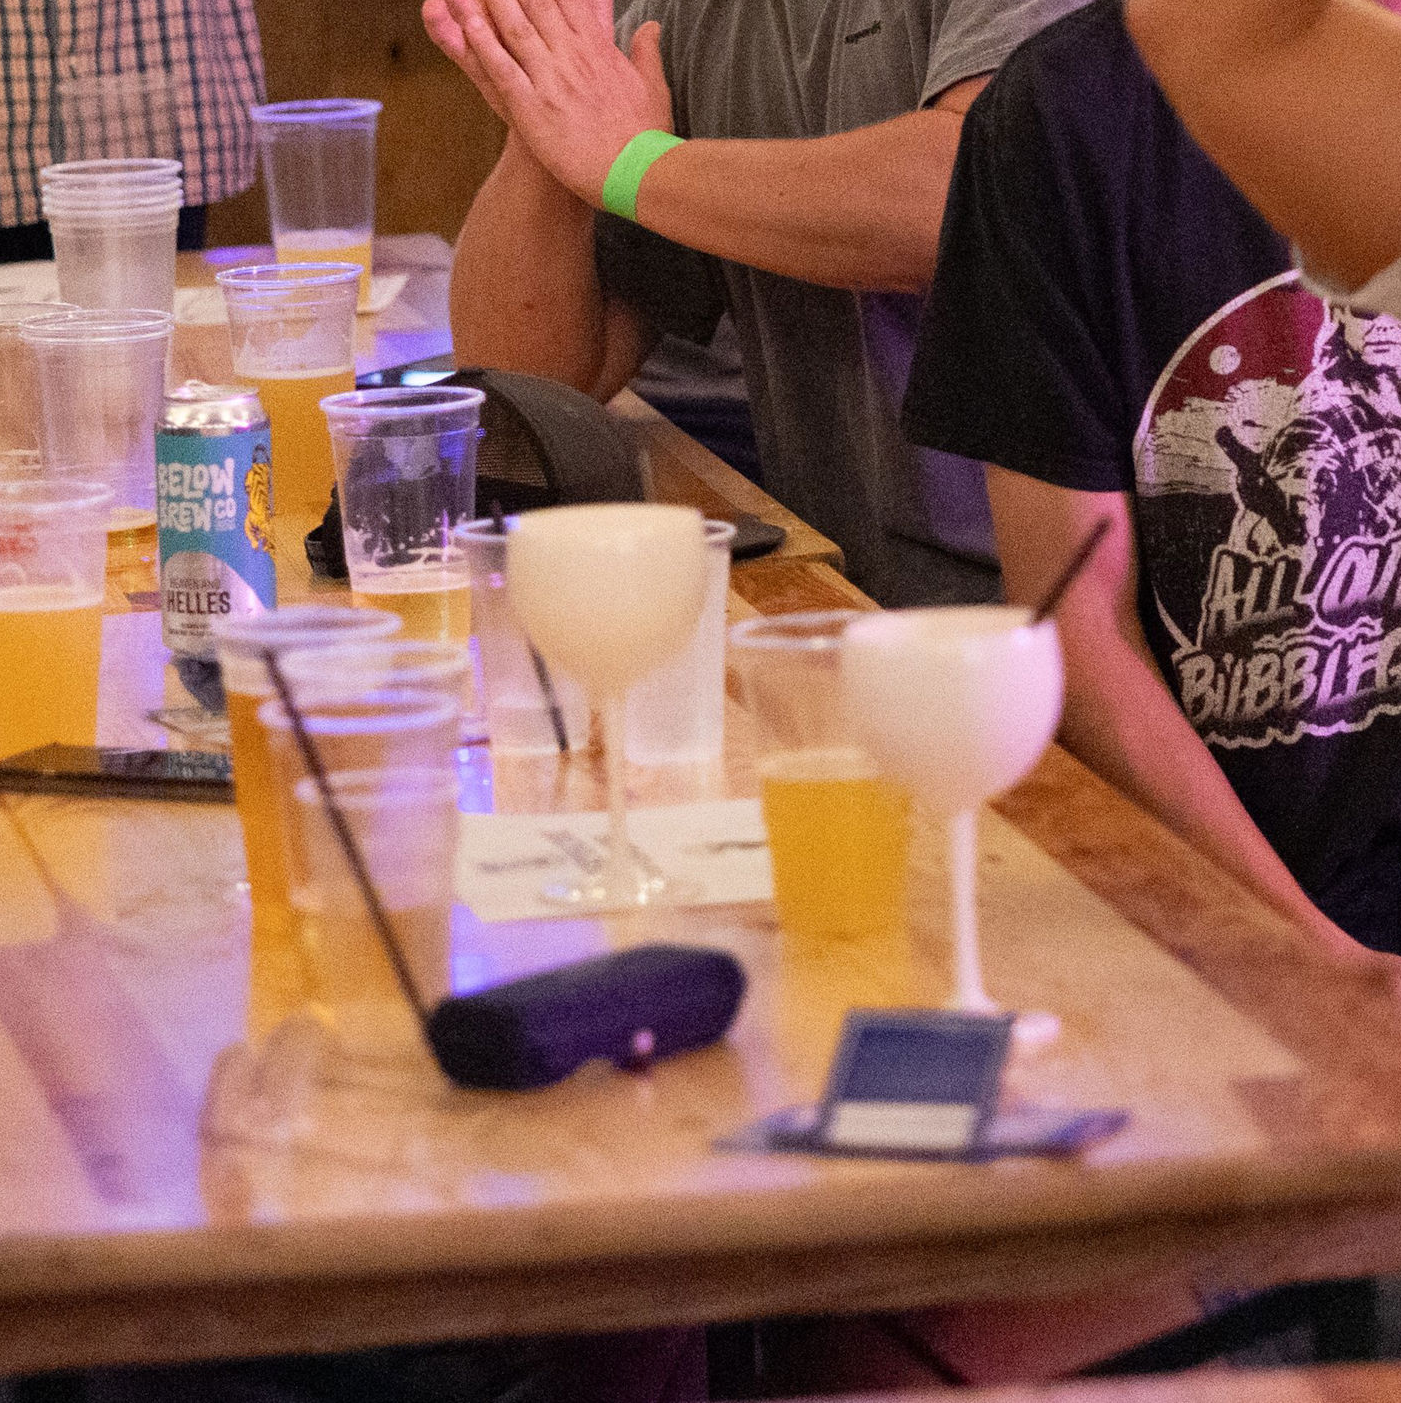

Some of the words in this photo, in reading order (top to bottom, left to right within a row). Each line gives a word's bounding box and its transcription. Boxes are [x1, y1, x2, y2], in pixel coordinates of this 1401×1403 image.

[158, 458, 235, 499] BELOW
[166, 590, 230, 614] HELLES
[1206, 552, 1296, 636] ALL
